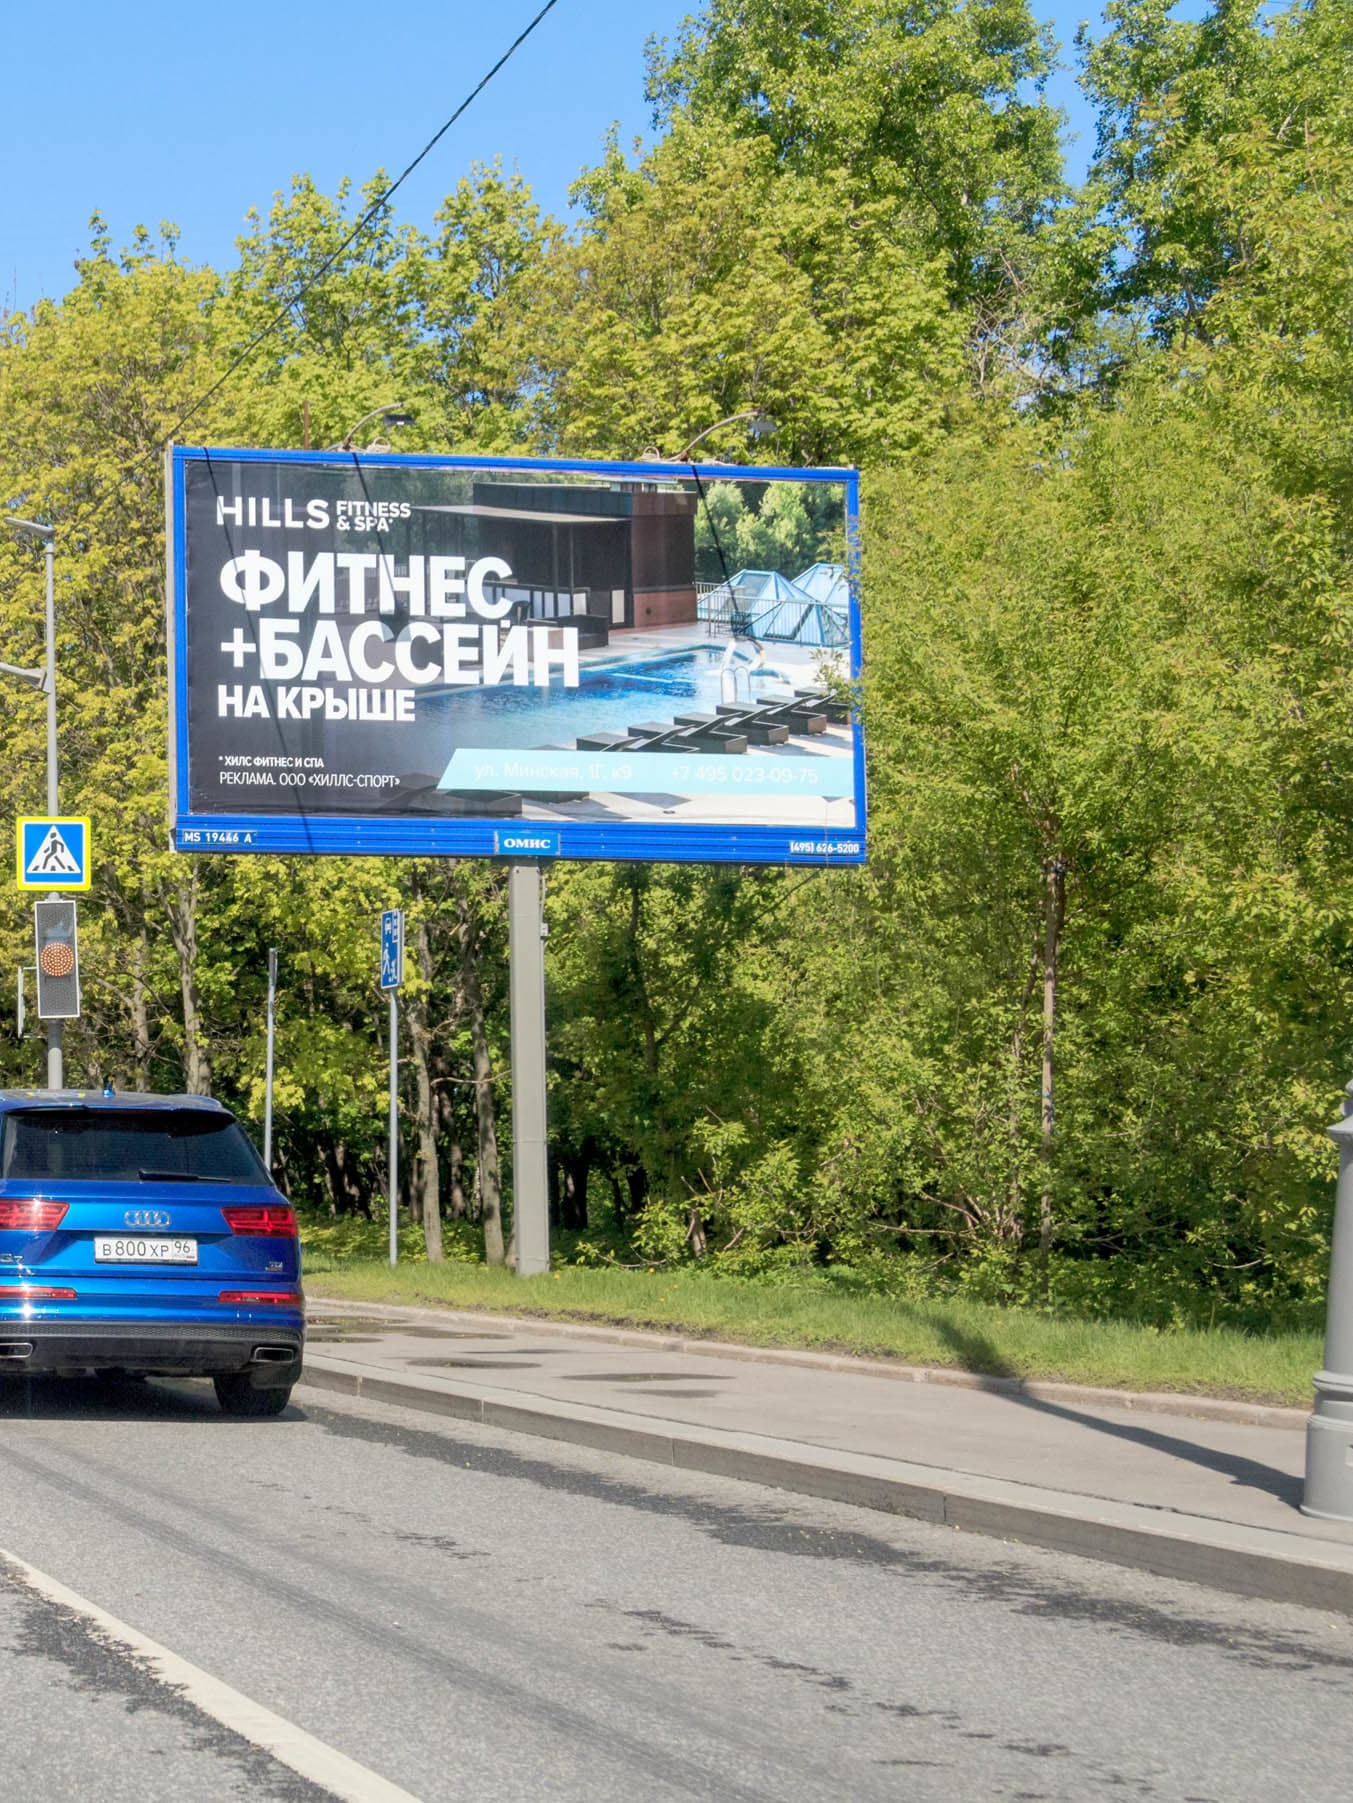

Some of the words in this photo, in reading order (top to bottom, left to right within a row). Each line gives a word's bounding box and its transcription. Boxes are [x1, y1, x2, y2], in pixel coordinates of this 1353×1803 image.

[216, 496, 330, 529] HILLS
[336, 501, 411, 518] FITNESS
[336, 516, 350, 531] &
[220, 550, 513, 619] ФИТНЕС
[221, 617, 579, 687] +БАССЕЙН
[218, 685, 270, 718] НА
[277, 686, 416, 721] КРЫШЕ
[253, 757, 294, 767] ФИТНЕС
[295, 757, 302, 767] И
[304, 757, 325, 768] СПА
[220, 771, 276, 785] РЕКЛАМА.
[279, 772, 306, 786] ООО
[308, 773, 400, 788] «ХИЛЛС-СПОРТ»
[184, 832, 200, 842] MS
[244, 833, 252, 843] A
[503, 838, 551, 849] ОМИС
[790, 841, 814, 853] (495)
